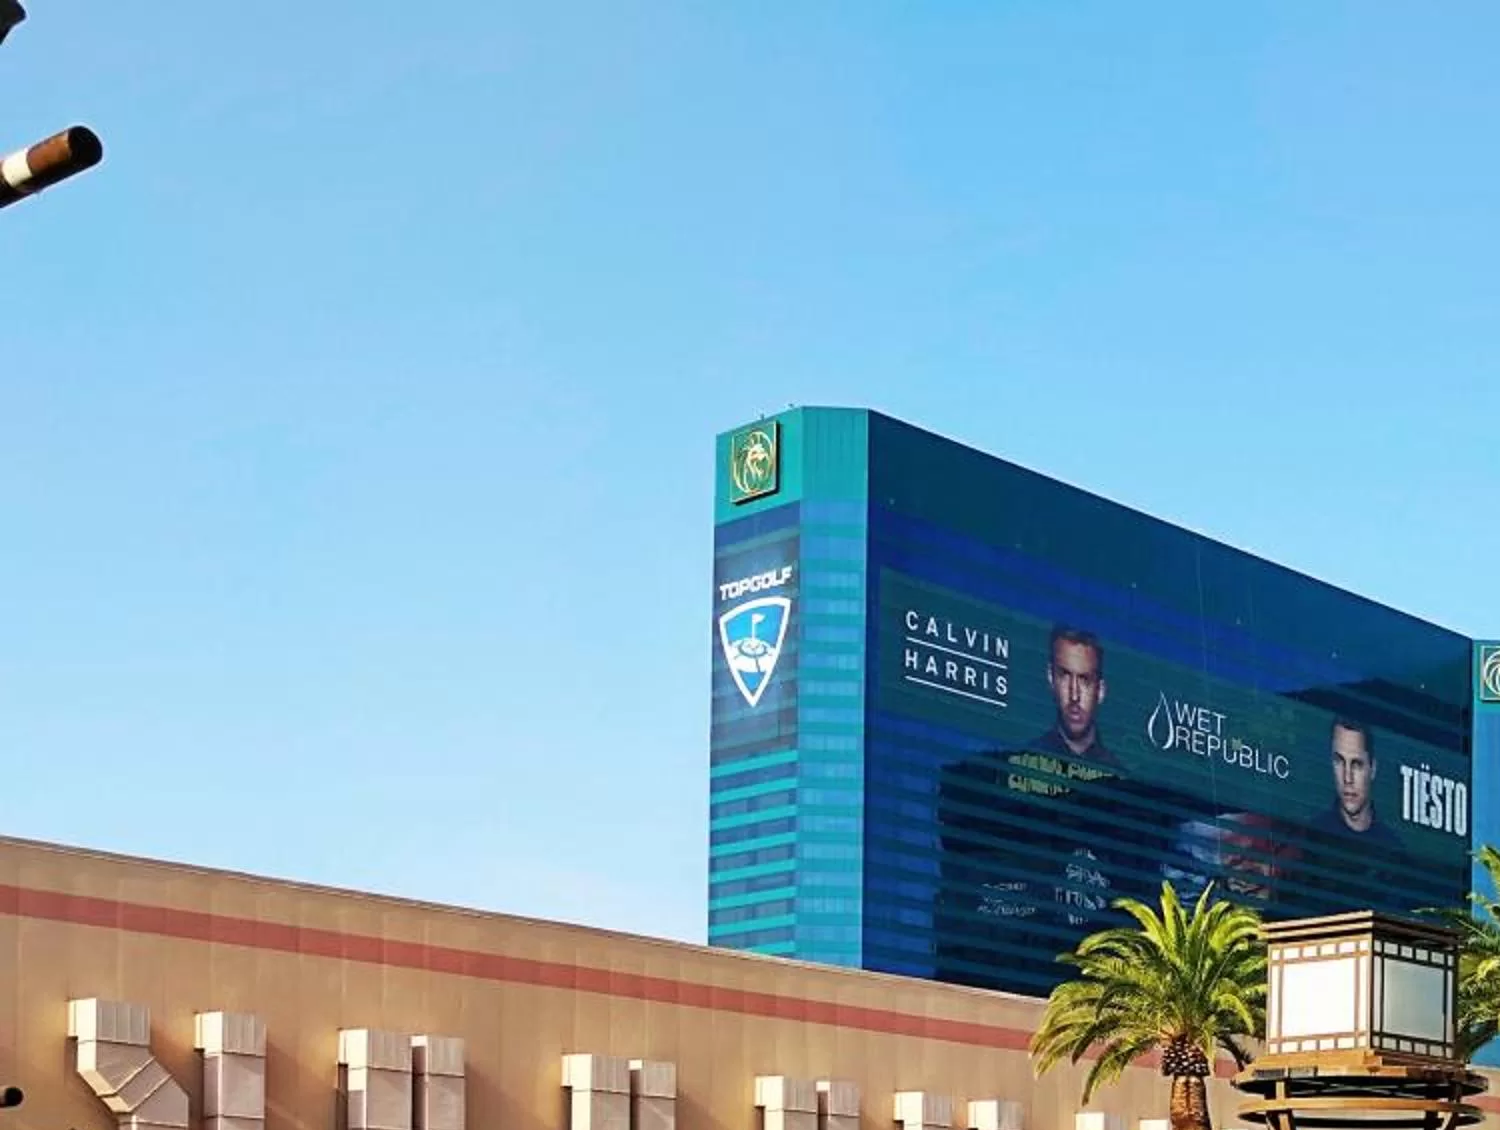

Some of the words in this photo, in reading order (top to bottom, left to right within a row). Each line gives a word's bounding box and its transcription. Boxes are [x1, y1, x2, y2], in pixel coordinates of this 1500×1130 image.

[719, 565, 793, 601] TOPGOLF
[906, 611, 1009, 658] CALVIN
[905, 649, 1009, 695] HARRIS
[1175, 700, 1227, 736] WET
[1175, 725, 1290, 779] REPUBLIC
